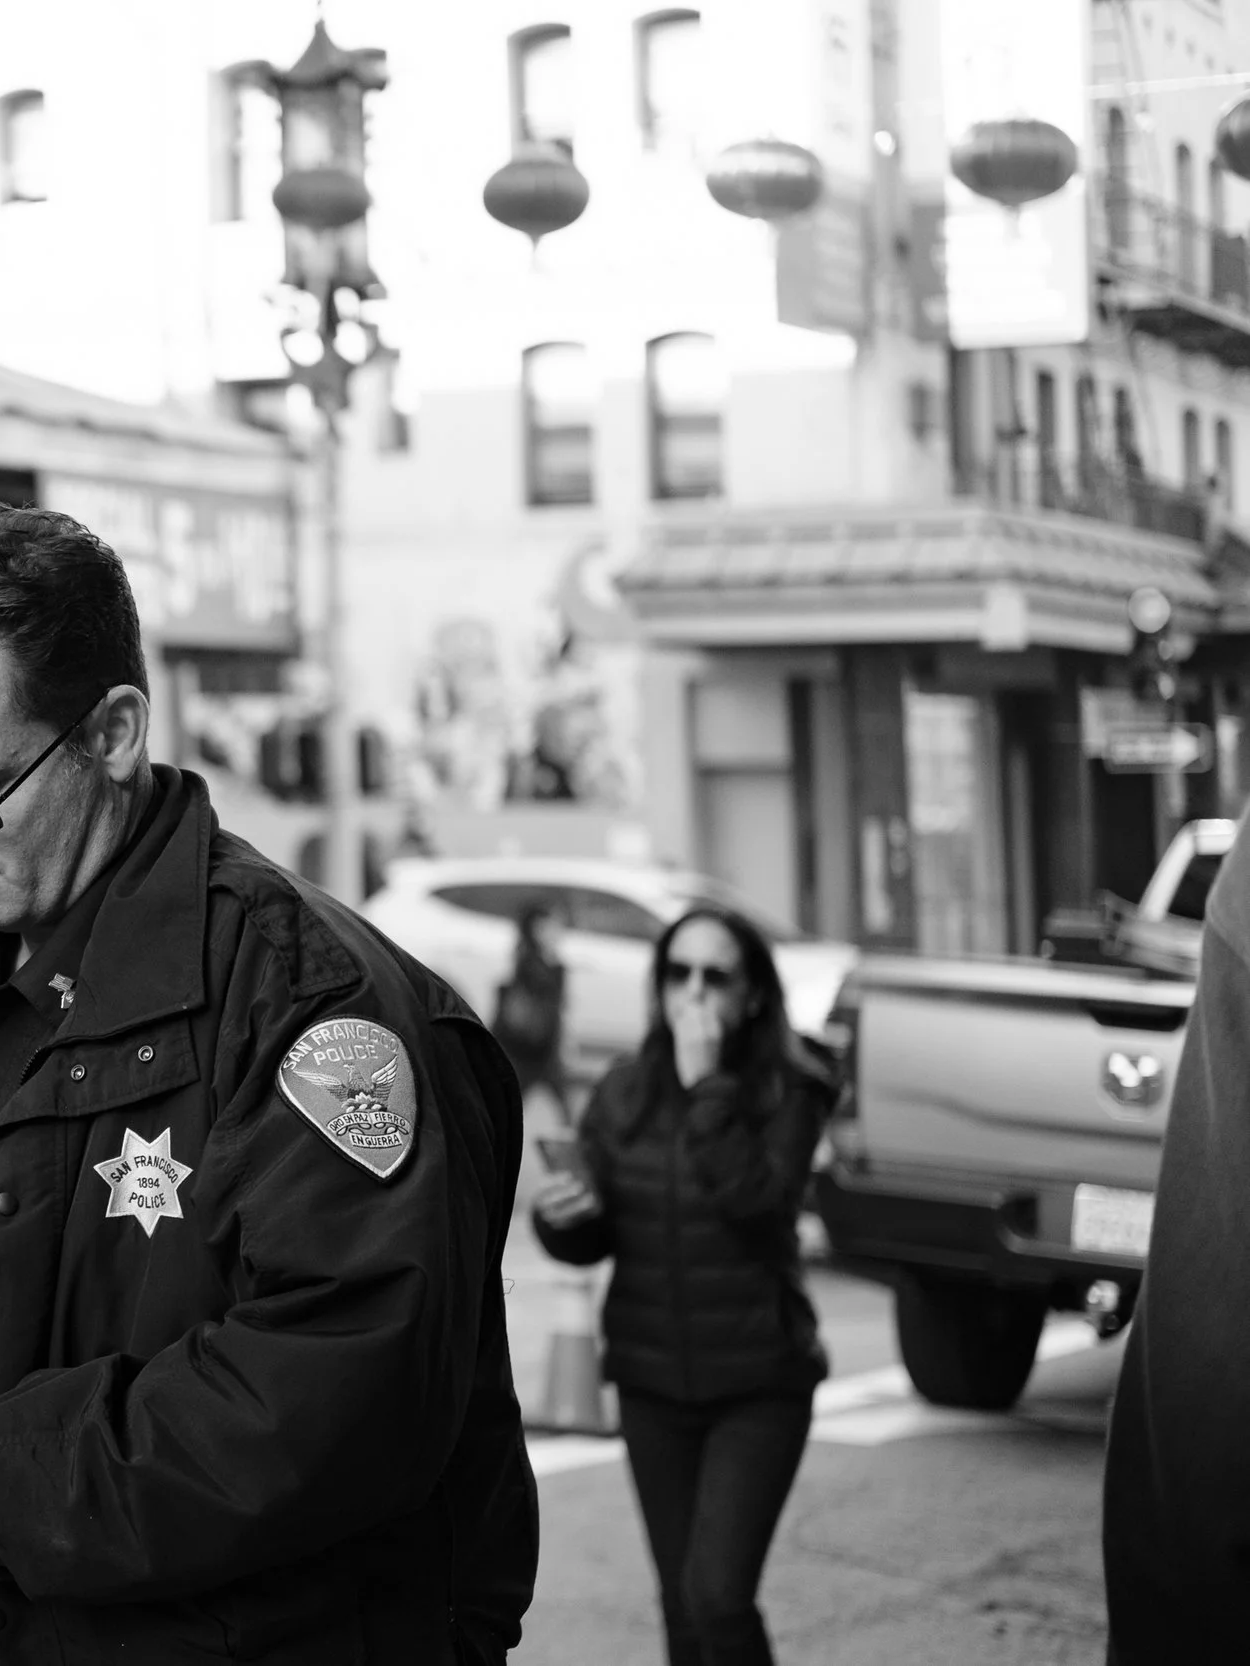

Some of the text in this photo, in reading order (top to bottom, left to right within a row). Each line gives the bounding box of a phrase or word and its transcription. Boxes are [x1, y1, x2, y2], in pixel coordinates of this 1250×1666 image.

[283, 1024, 400, 1070] SAN FRANCISCO
[312, 1044, 379, 1066] POLICE
[329, 1113, 407, 1132] ORO EN PAZ FIERRO
[351, 1134, 401, 1146] EN GUERRA
[110, 1155, 179, 1184] SAN FRANCISCO
[137, 1177, 160, 1189] 1894
[128, 1191, 167, 1209] POLICE
